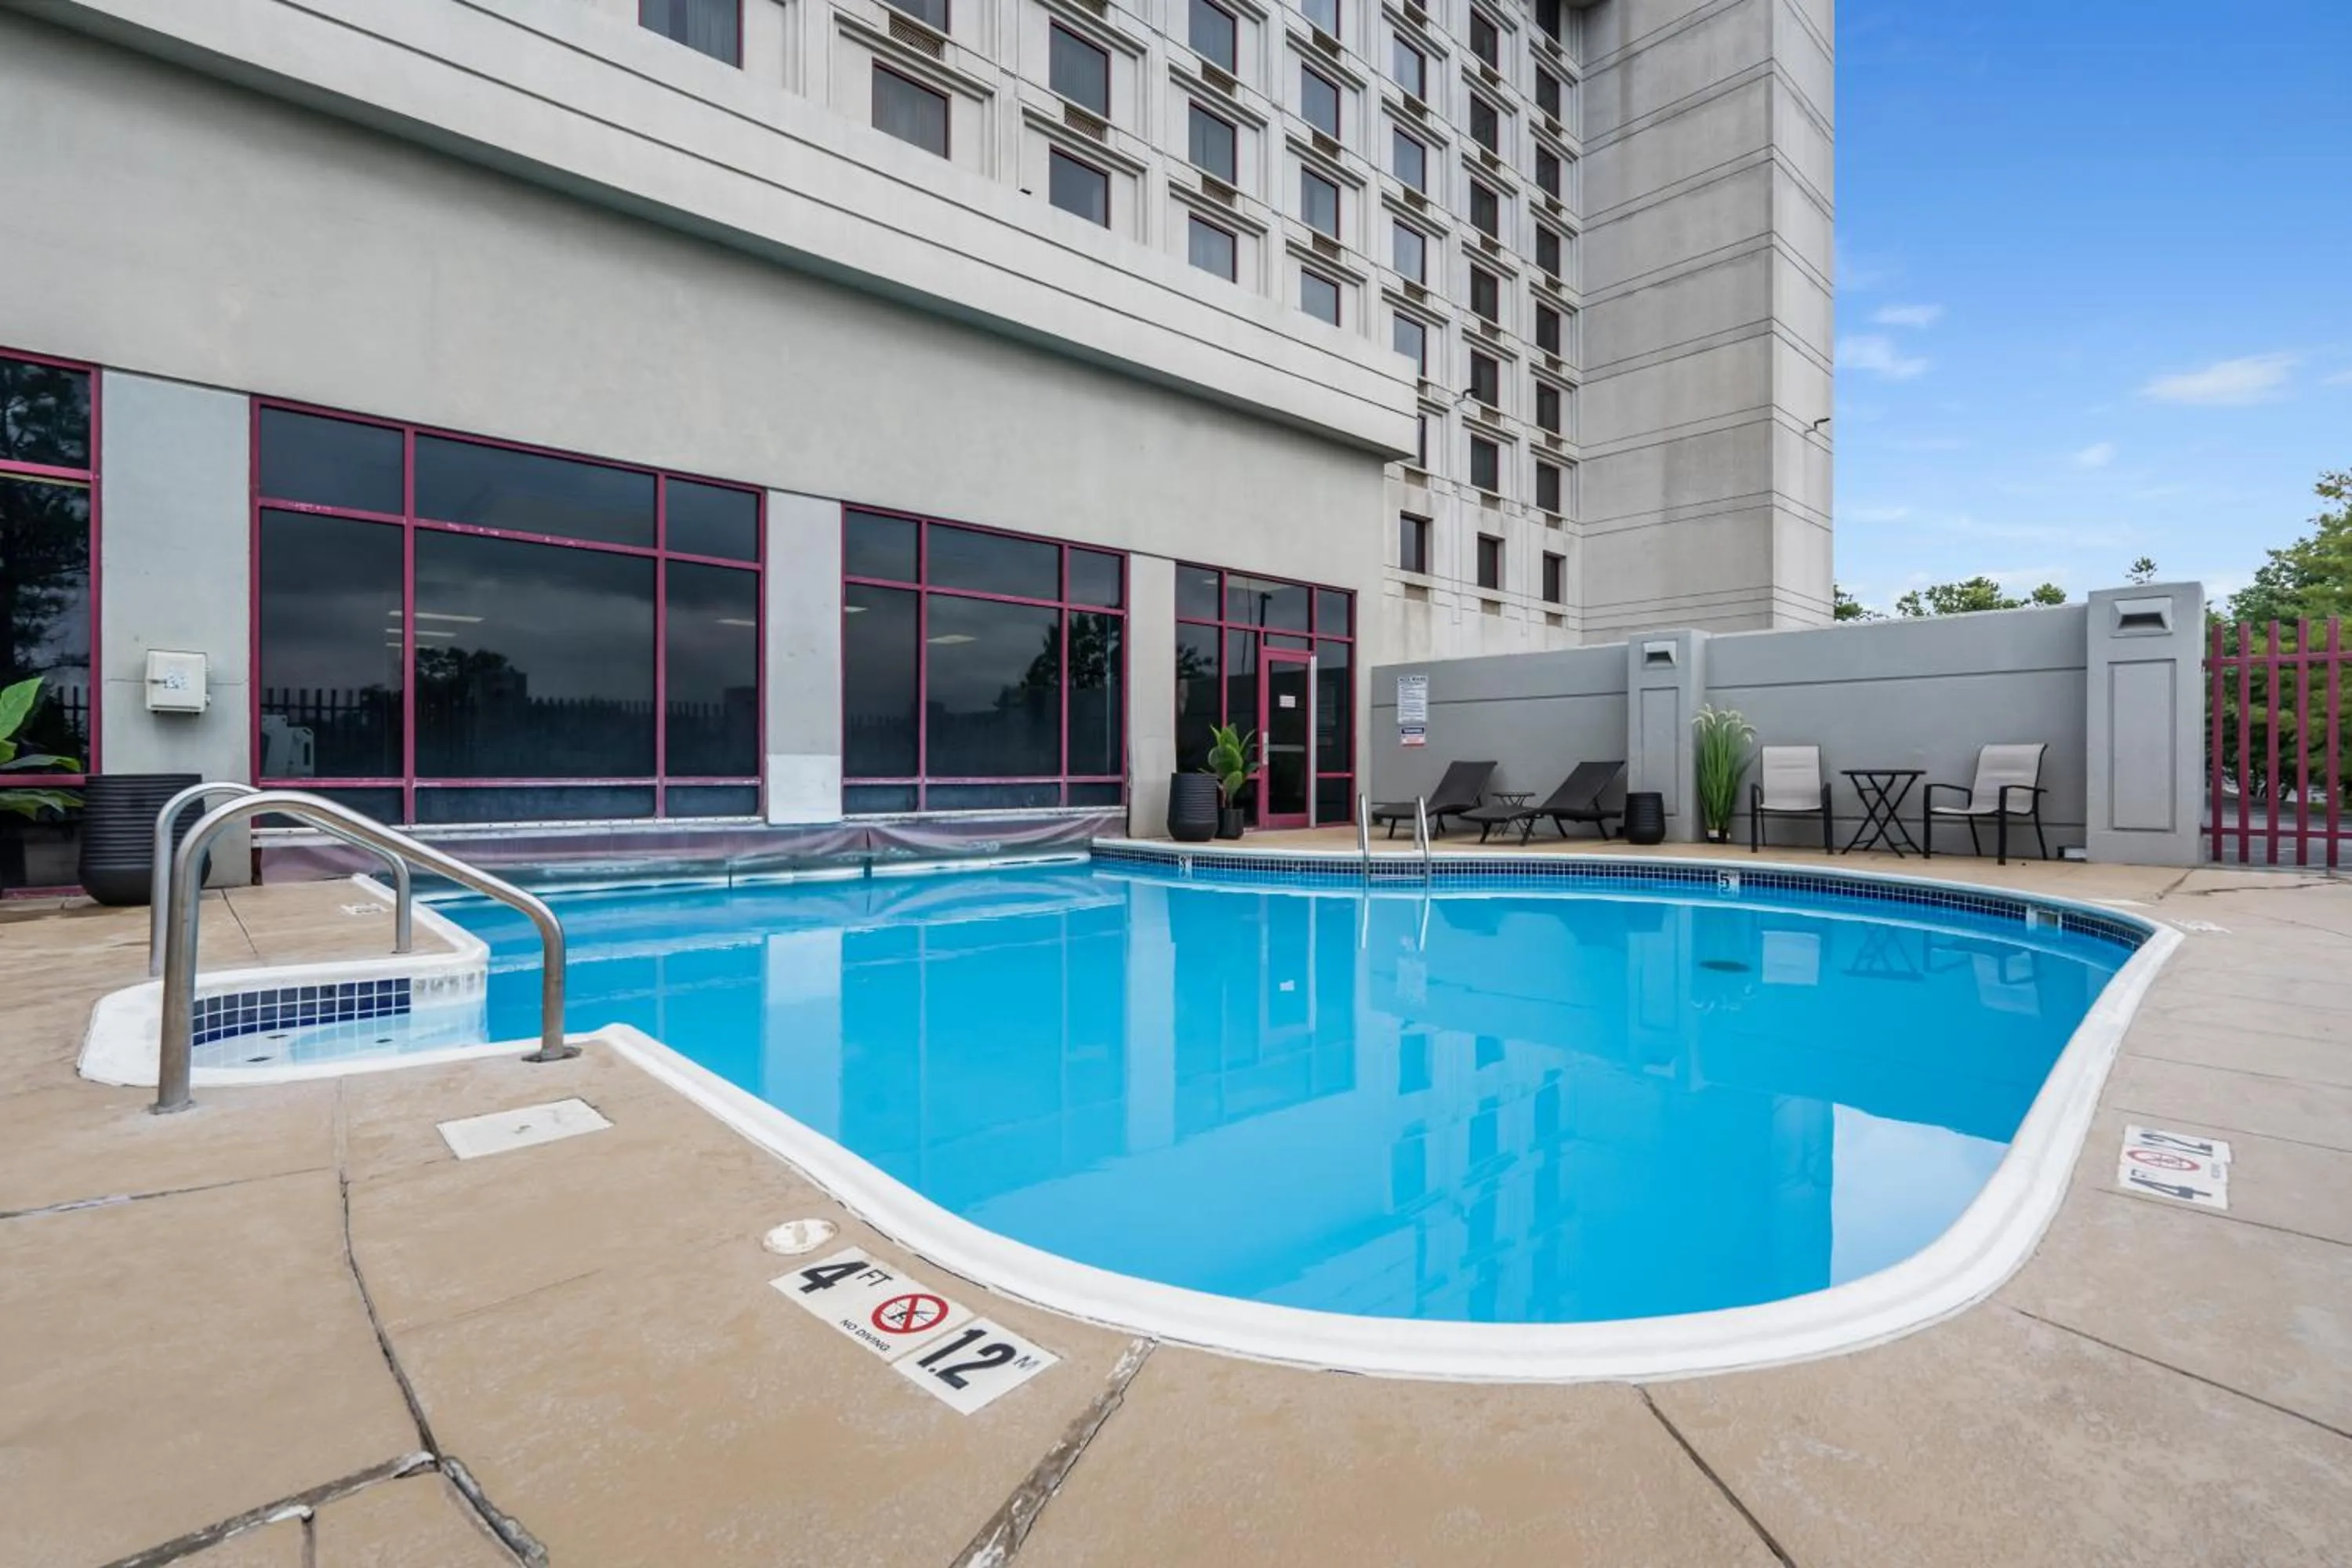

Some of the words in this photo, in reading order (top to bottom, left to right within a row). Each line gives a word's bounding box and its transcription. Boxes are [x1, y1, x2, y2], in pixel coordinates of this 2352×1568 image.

[2129, 1177, 2212, 1199] 4
[799, 1261, 870, 1294] 4
[855, 1269, 894, 1287] FT
[840, 1319, 858, 1330] NO
[916, 1329, 1017, 1391] 1.2
[1014, 1355, 1041, 1370] M
